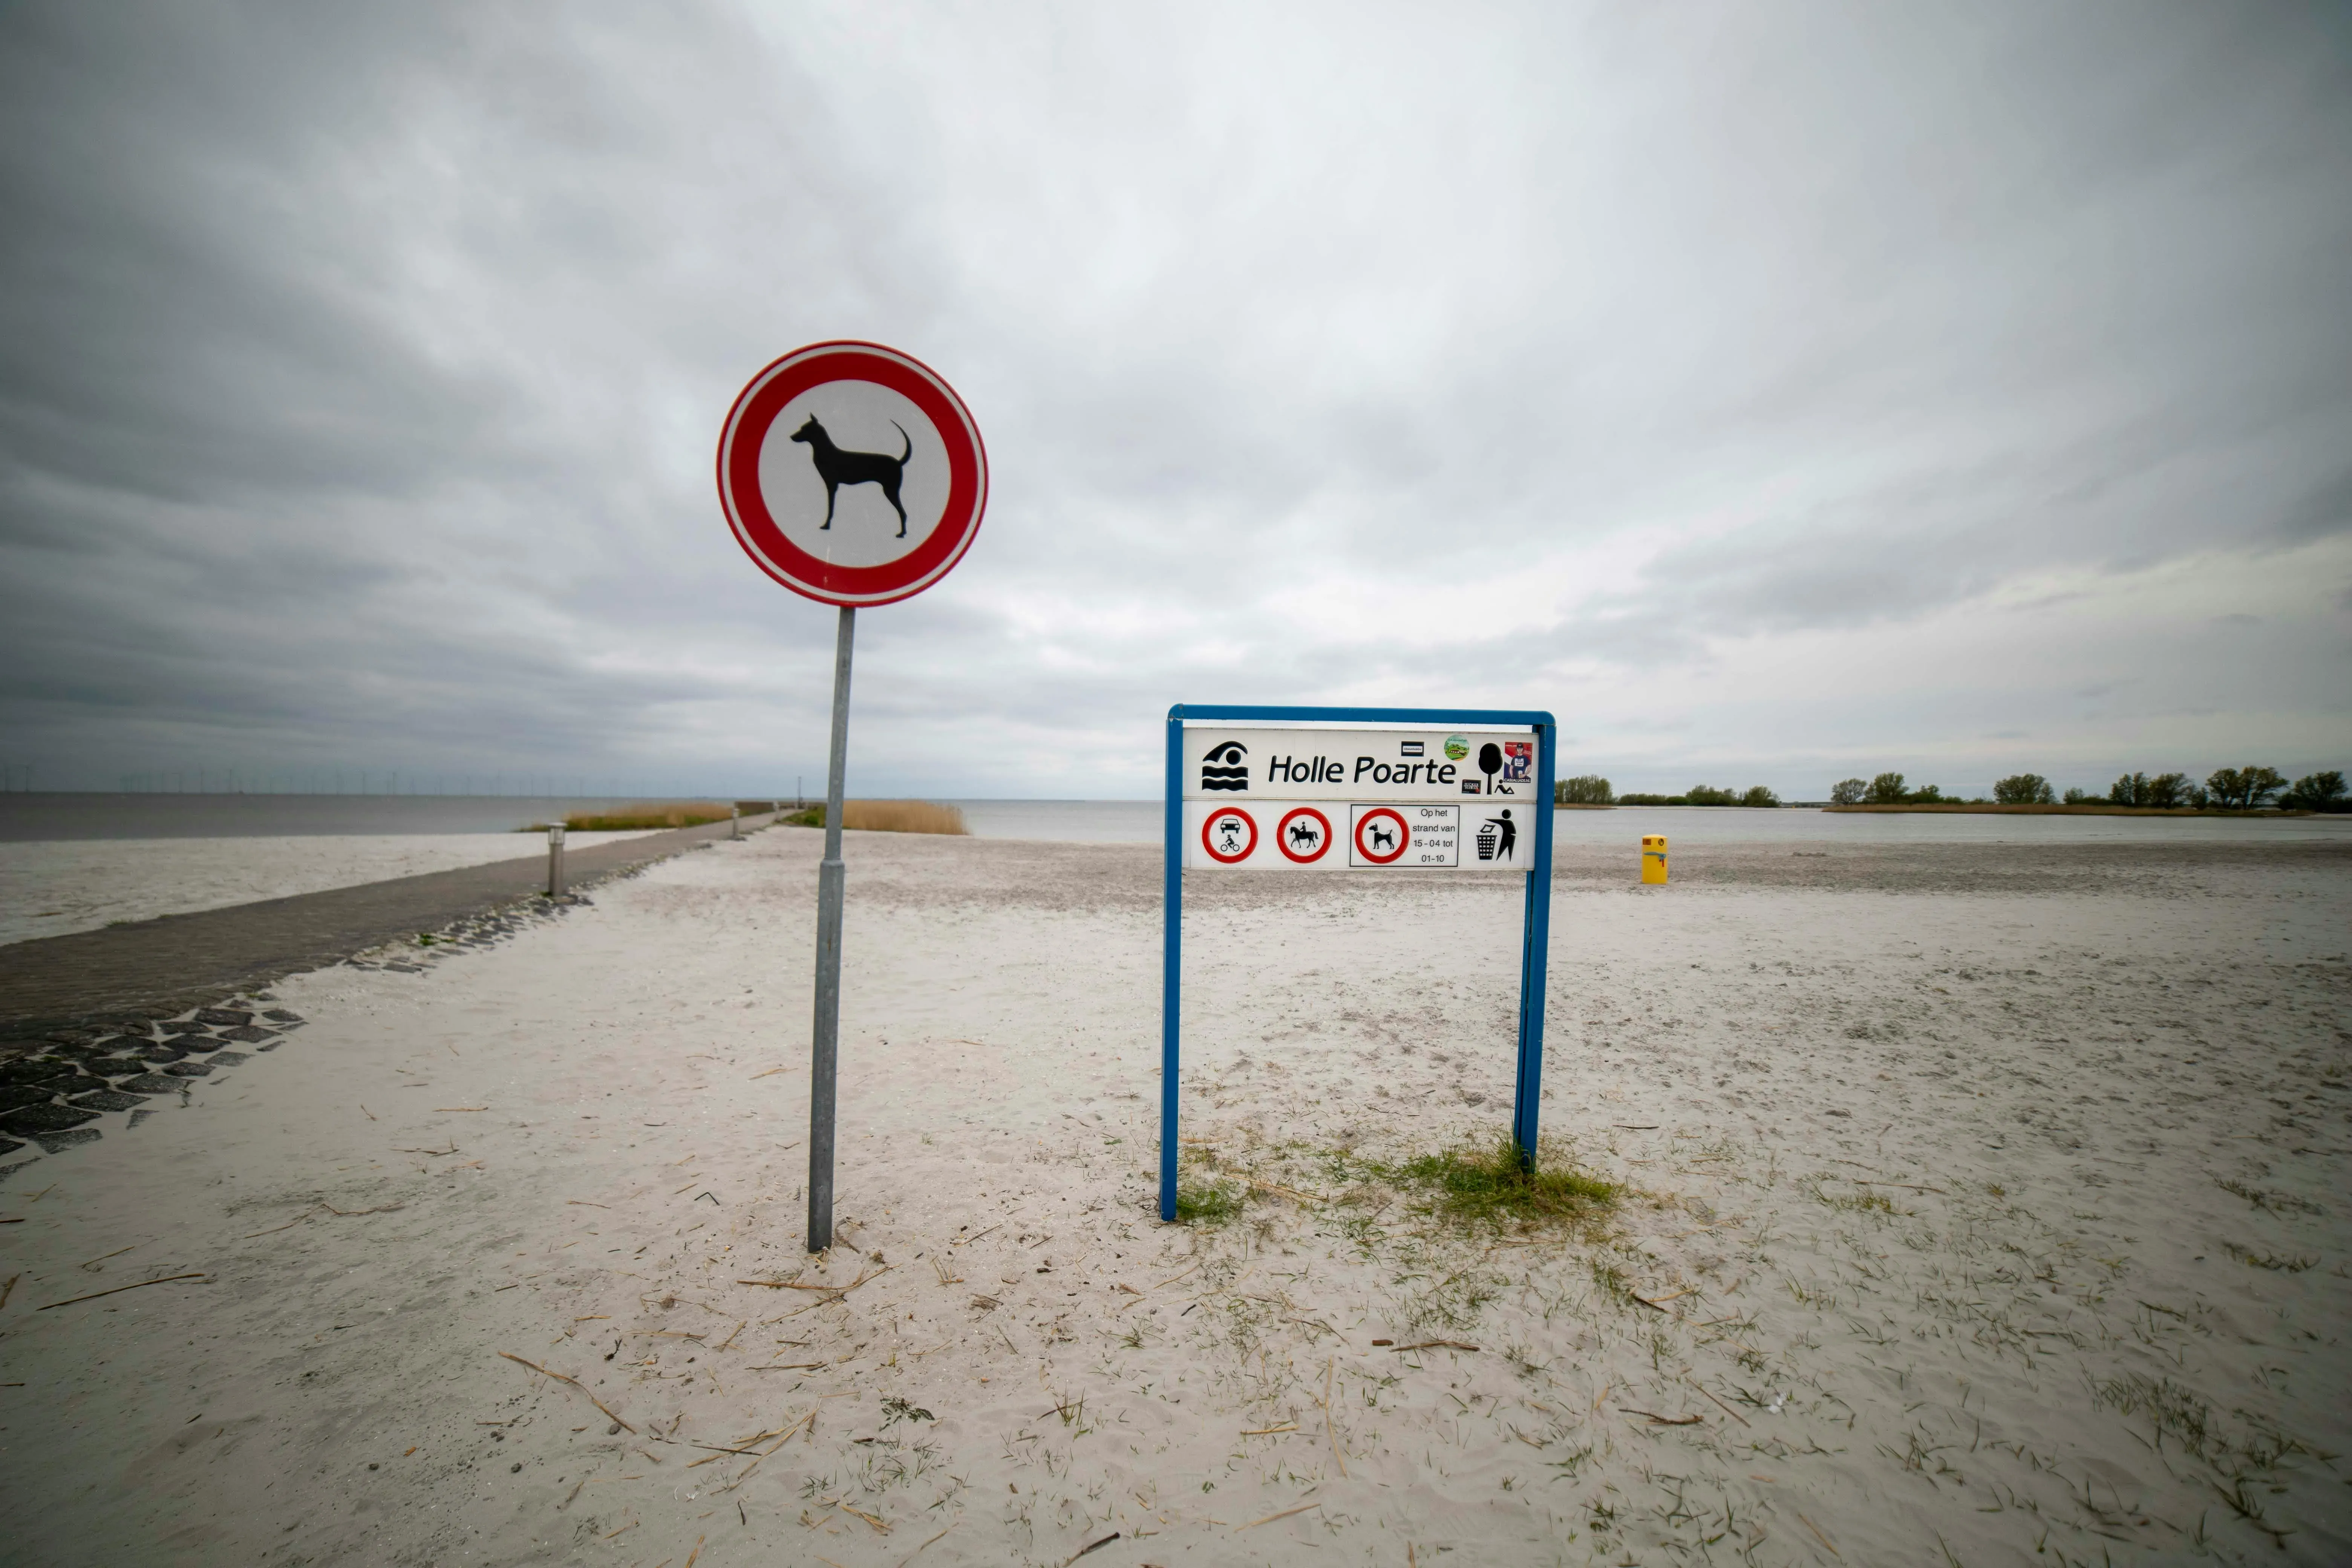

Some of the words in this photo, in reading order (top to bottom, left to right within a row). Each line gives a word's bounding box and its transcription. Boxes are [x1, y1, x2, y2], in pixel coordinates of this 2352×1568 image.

[1268, 755, 1344, 782] Holle
[1354, 756, 1456, 784] Poarte
[1421, 808, 1433, 818] Op
